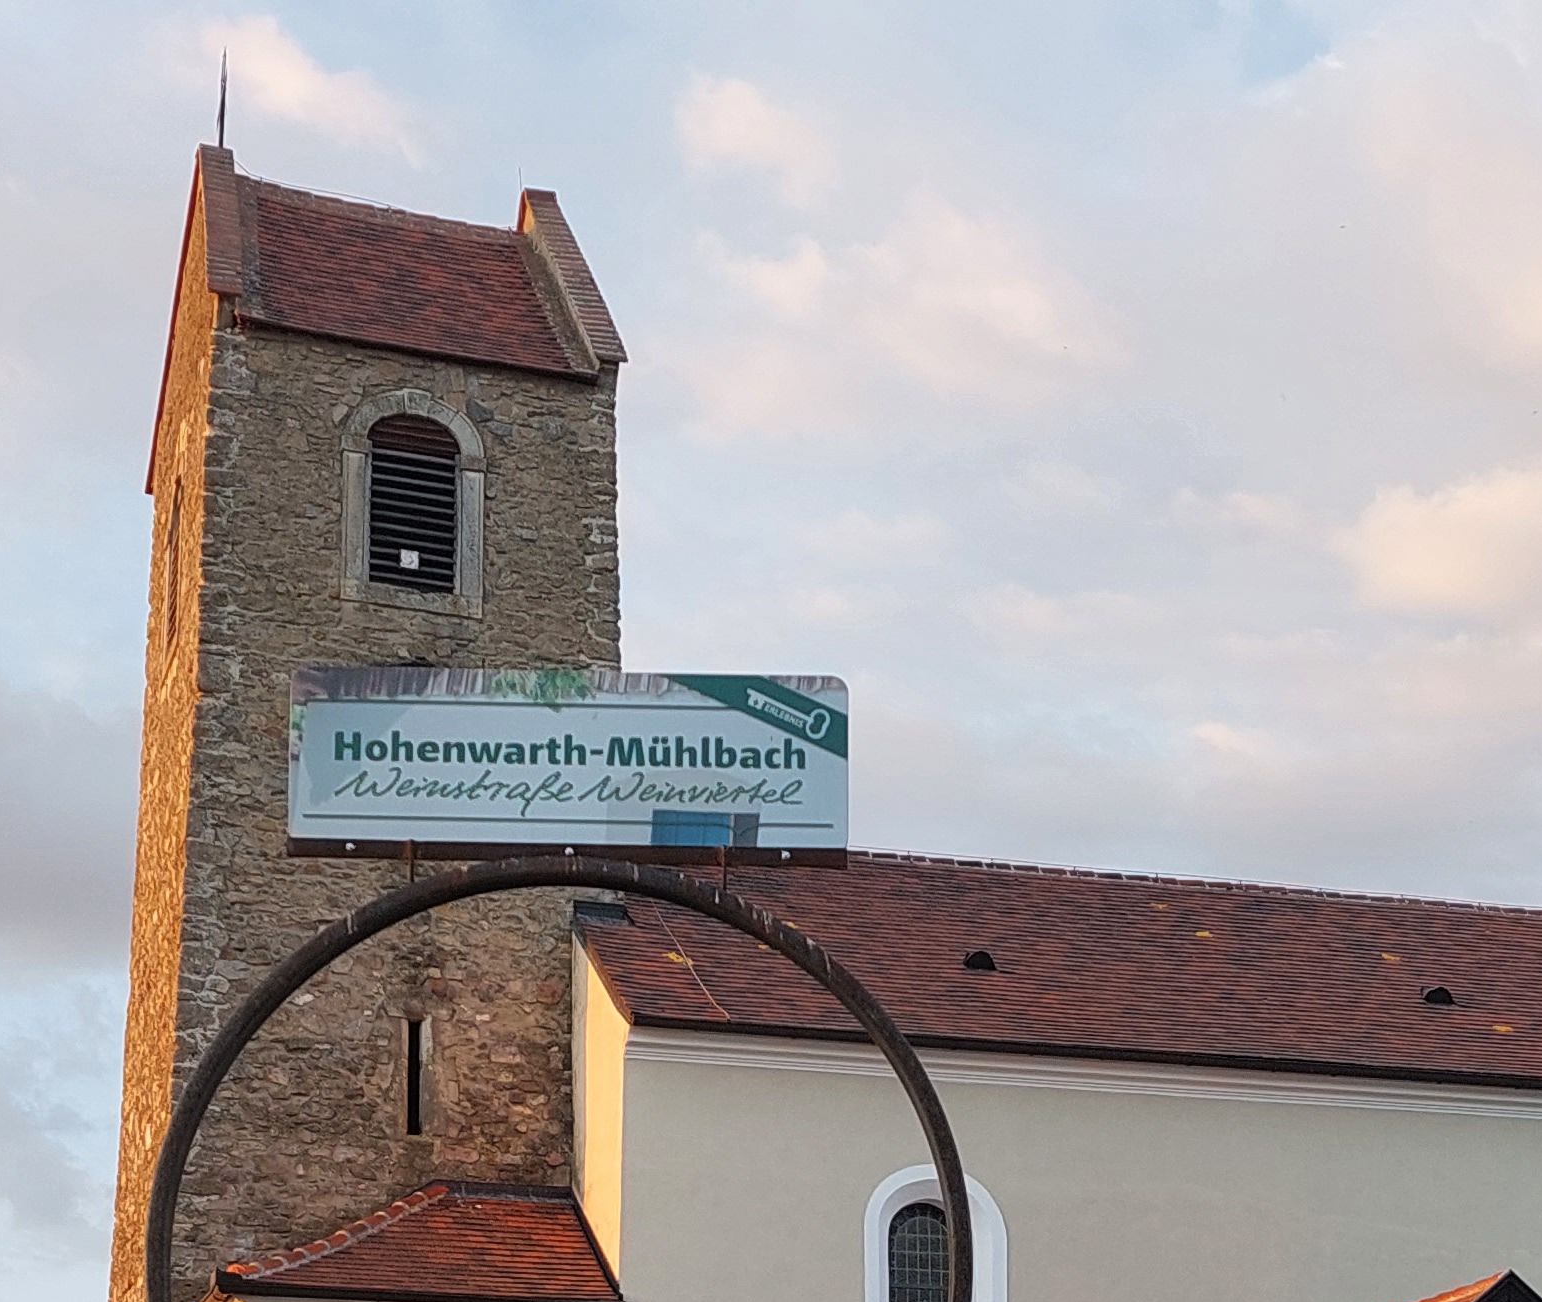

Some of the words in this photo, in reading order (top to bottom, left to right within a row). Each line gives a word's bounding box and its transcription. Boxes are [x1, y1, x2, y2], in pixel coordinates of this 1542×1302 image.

[334, 730, 806, 770] Hohenwarth-Mühlbach
[334, 766, 574, 818] Weinstraße
[577, 771, 803, 804] Weinviertel
